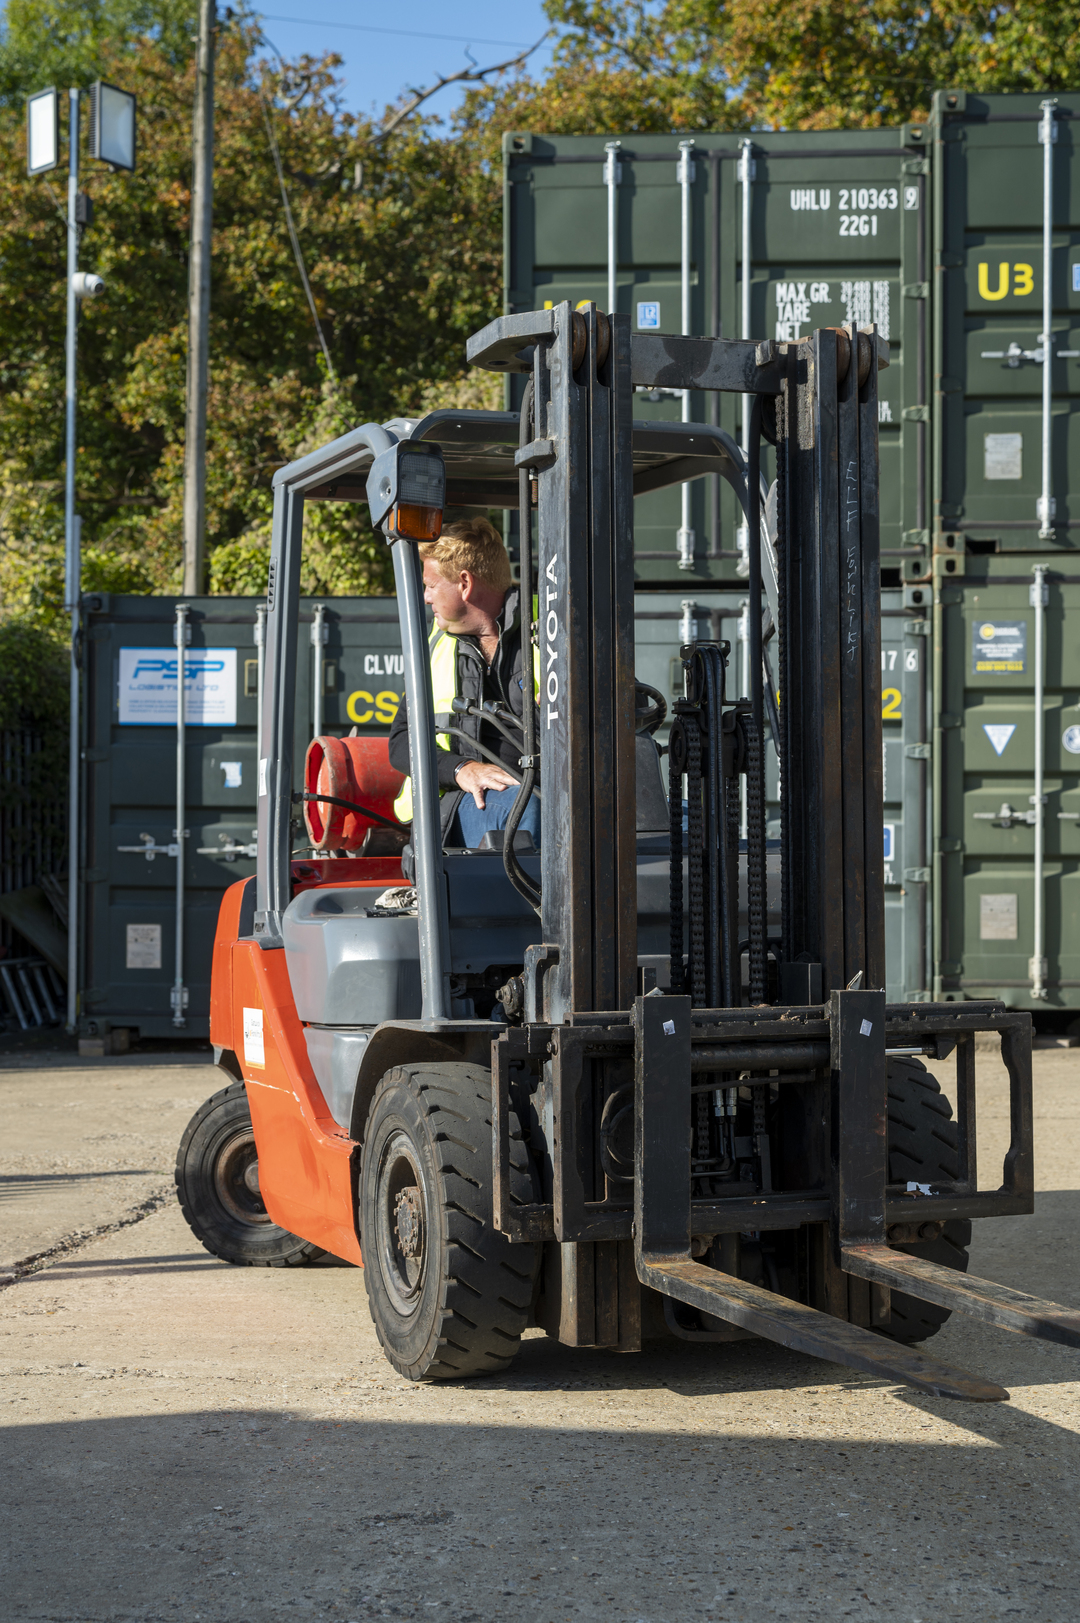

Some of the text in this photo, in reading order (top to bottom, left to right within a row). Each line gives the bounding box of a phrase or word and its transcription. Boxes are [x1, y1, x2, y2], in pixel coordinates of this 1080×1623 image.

[790, 187, 917, 211] UHLU 210363 9
[839, 214, 878, 236] 22G1
[978, 261, 1034, 301] U3
[776, 302, 811, 322] TARE
[546, 553, 559, 730] TOYOTA
[132, 659, 225, 679] PSP
[364, 654, 405, 675] CLVU
[905, 650, 917, 671] 6
[128, 684, 192, 692] LOGISTIS
